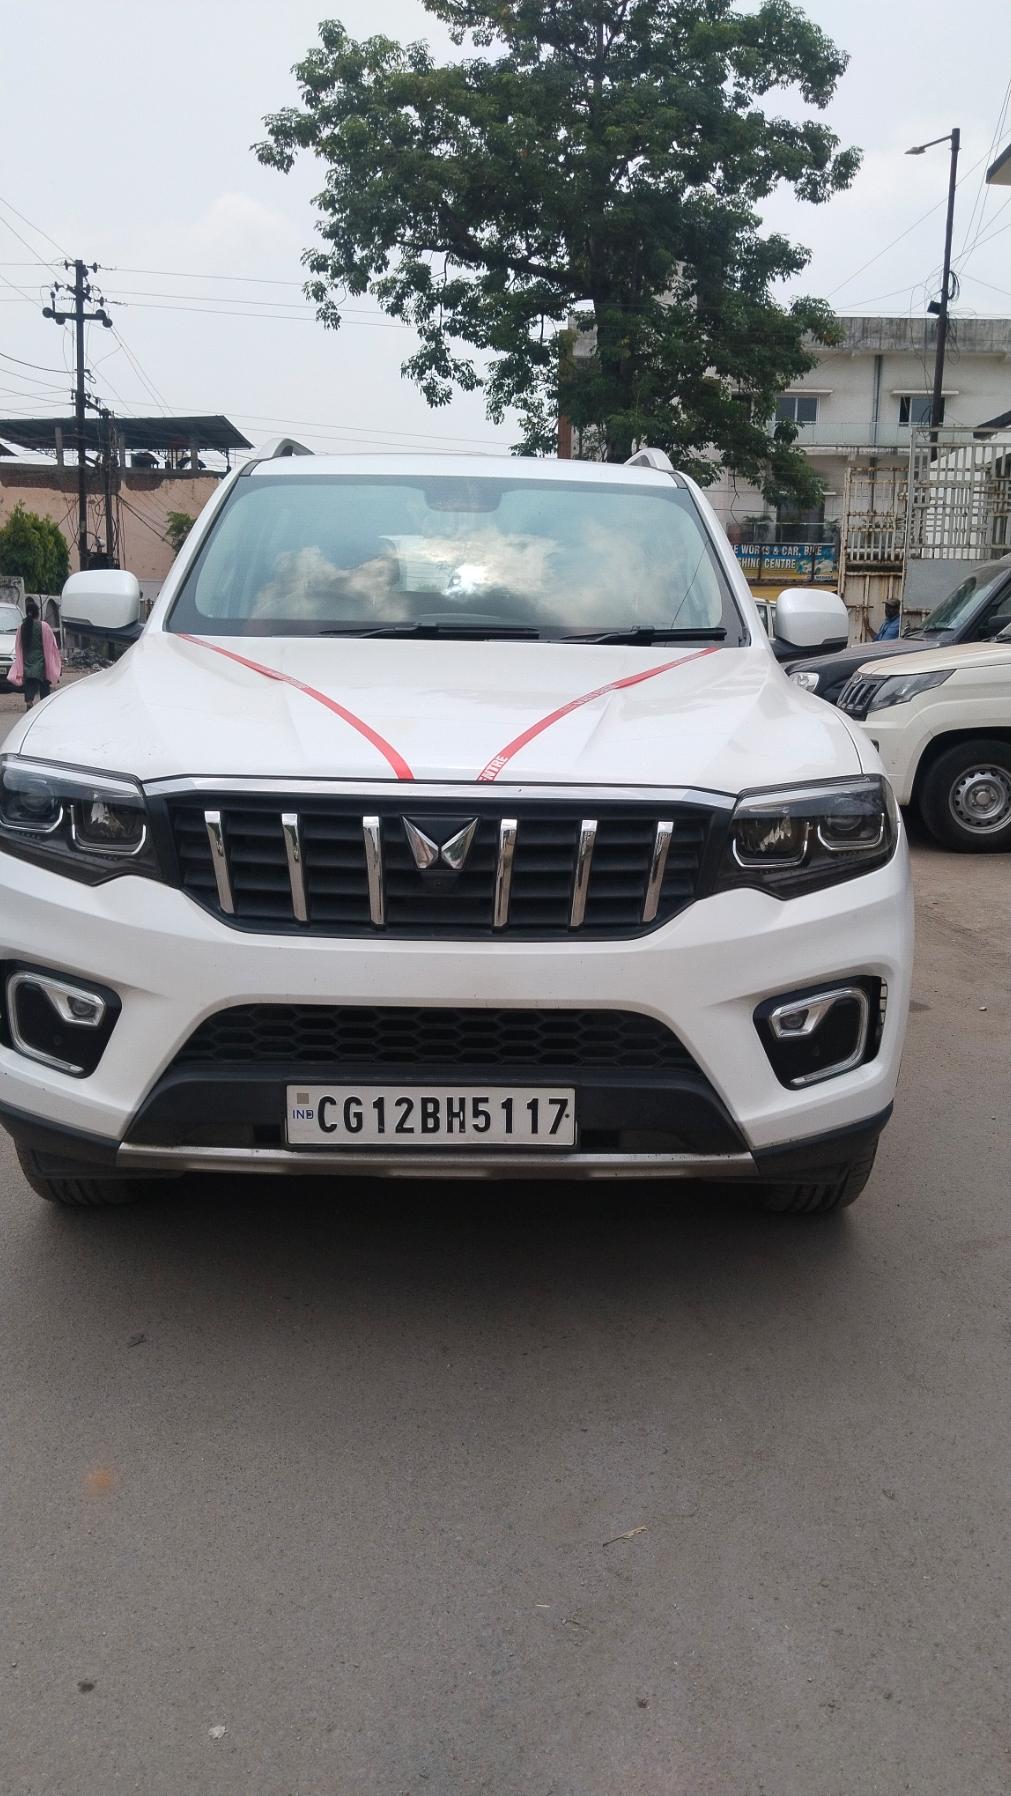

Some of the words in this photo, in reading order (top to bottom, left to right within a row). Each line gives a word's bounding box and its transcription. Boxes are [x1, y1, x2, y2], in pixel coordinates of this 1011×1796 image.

[773, 547, 779, 555] &
[764, 558, 796, 569] CENTRE
[292, 1109, 314, 1119] IND
[317, 1096, 569, 1134] CG12BH5117
